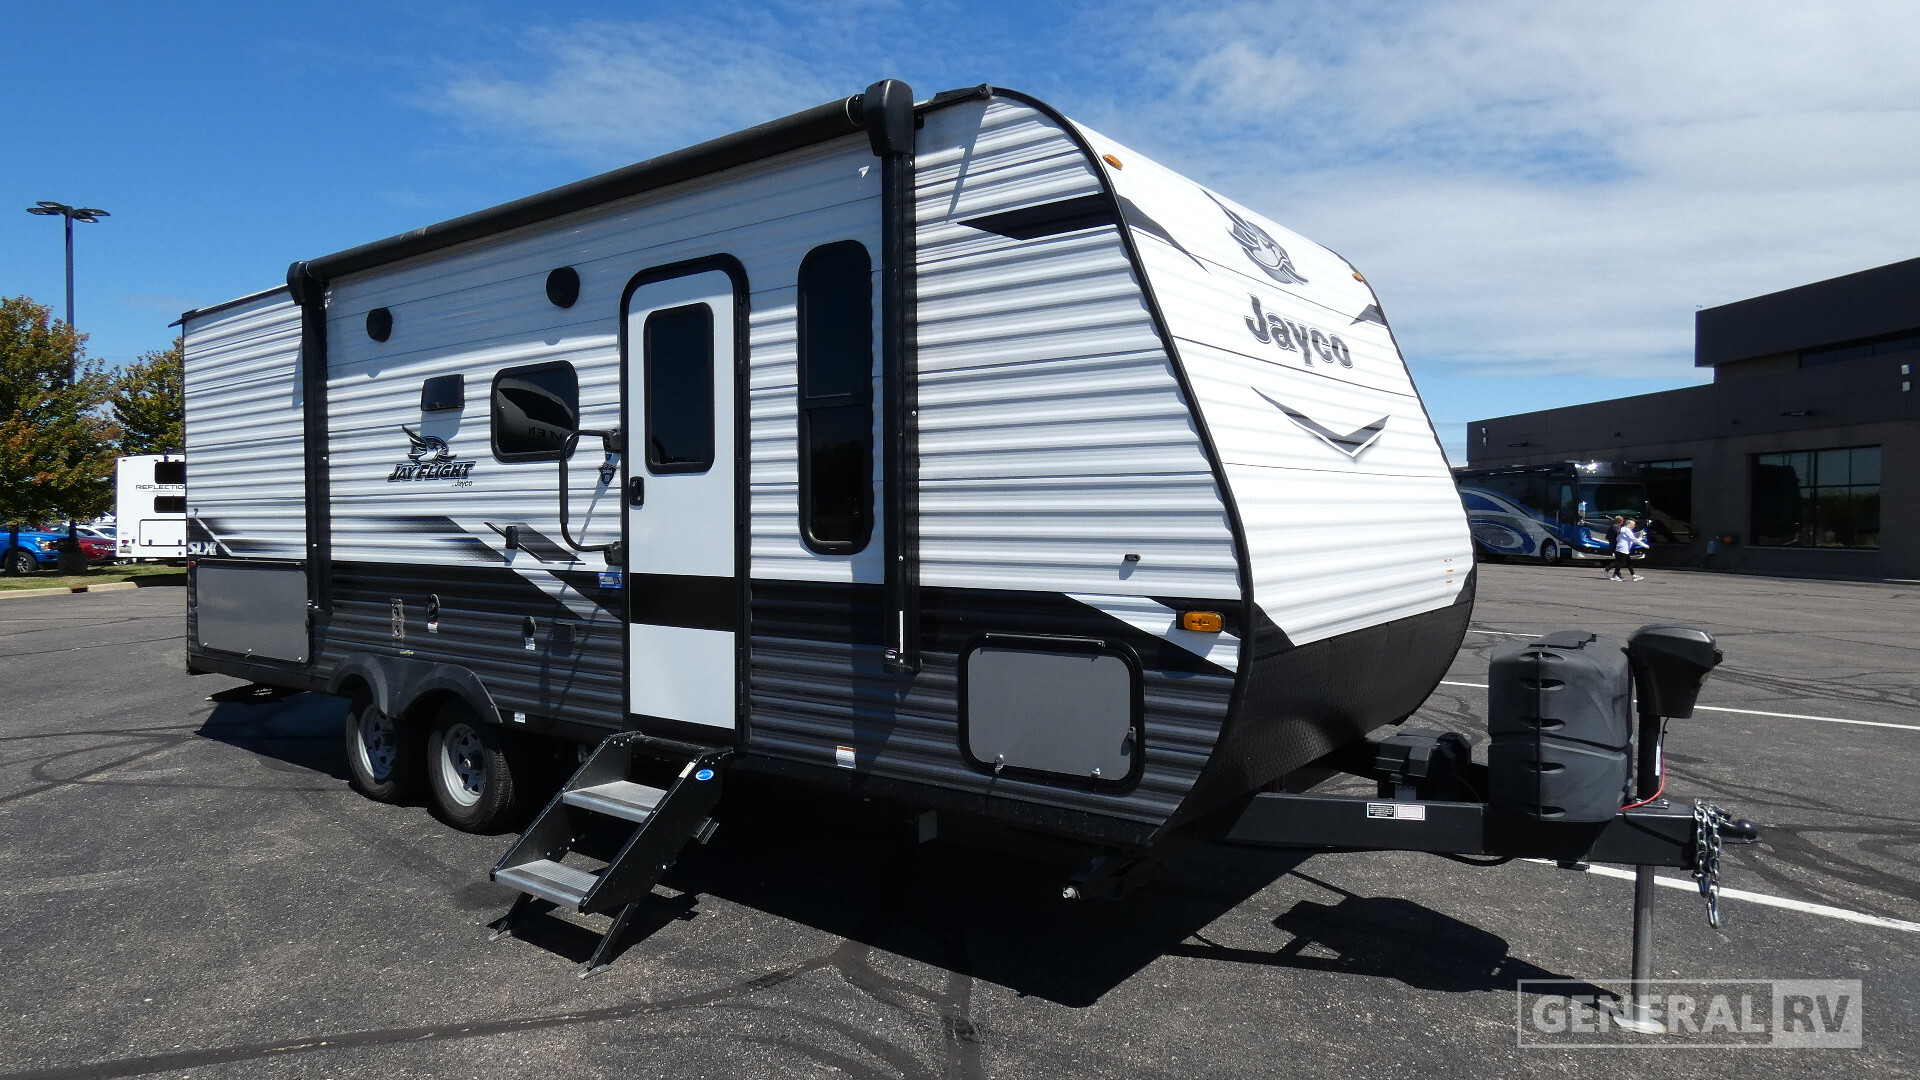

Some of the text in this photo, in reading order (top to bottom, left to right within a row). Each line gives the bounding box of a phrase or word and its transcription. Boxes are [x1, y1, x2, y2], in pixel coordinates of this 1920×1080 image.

[1243, 292, 1353, 369] Jayco
[387, 461, 476, 482] JAY FLIGHT
